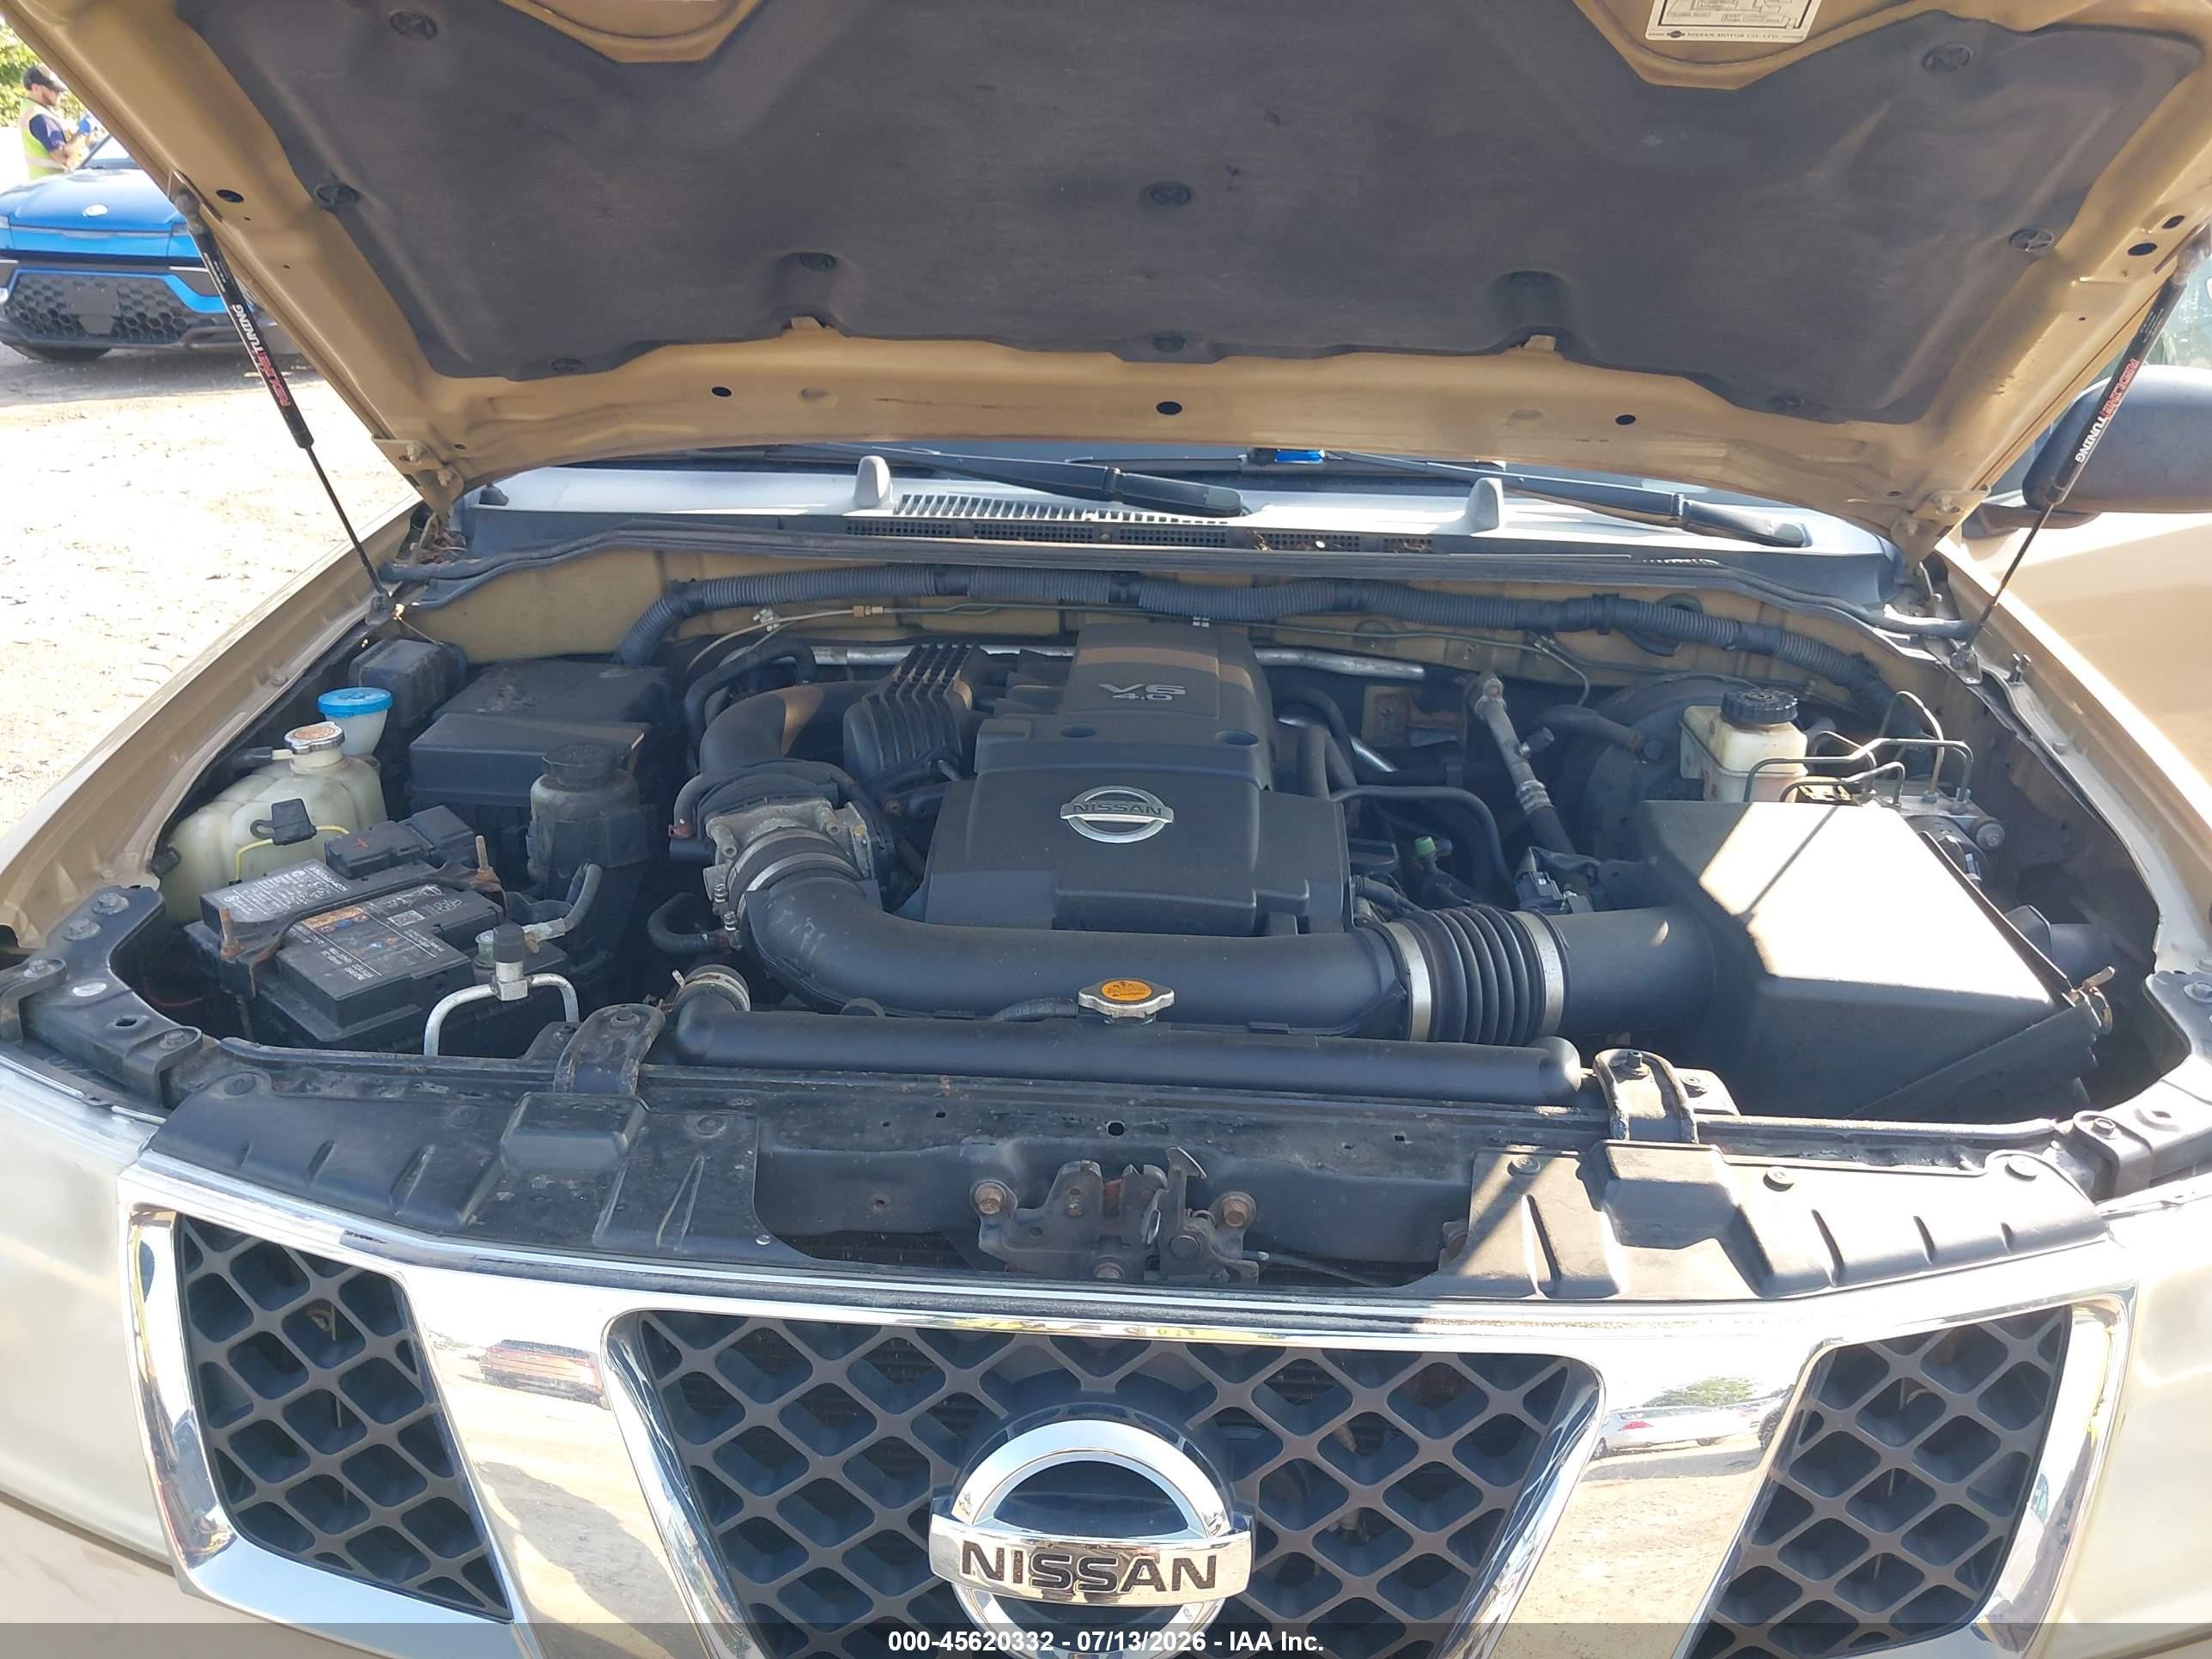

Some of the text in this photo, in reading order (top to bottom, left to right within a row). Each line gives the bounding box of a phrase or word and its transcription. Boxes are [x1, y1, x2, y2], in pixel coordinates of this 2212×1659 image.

[231, 304, 264, 354] TUNING
[2075, 416, 2107, 464] TUNING
[1098, 684, 1186, 695] V6
[1073, 803, 1162, 815] NISSAN
[960, 1539, 1218, 1593] NISSAN
